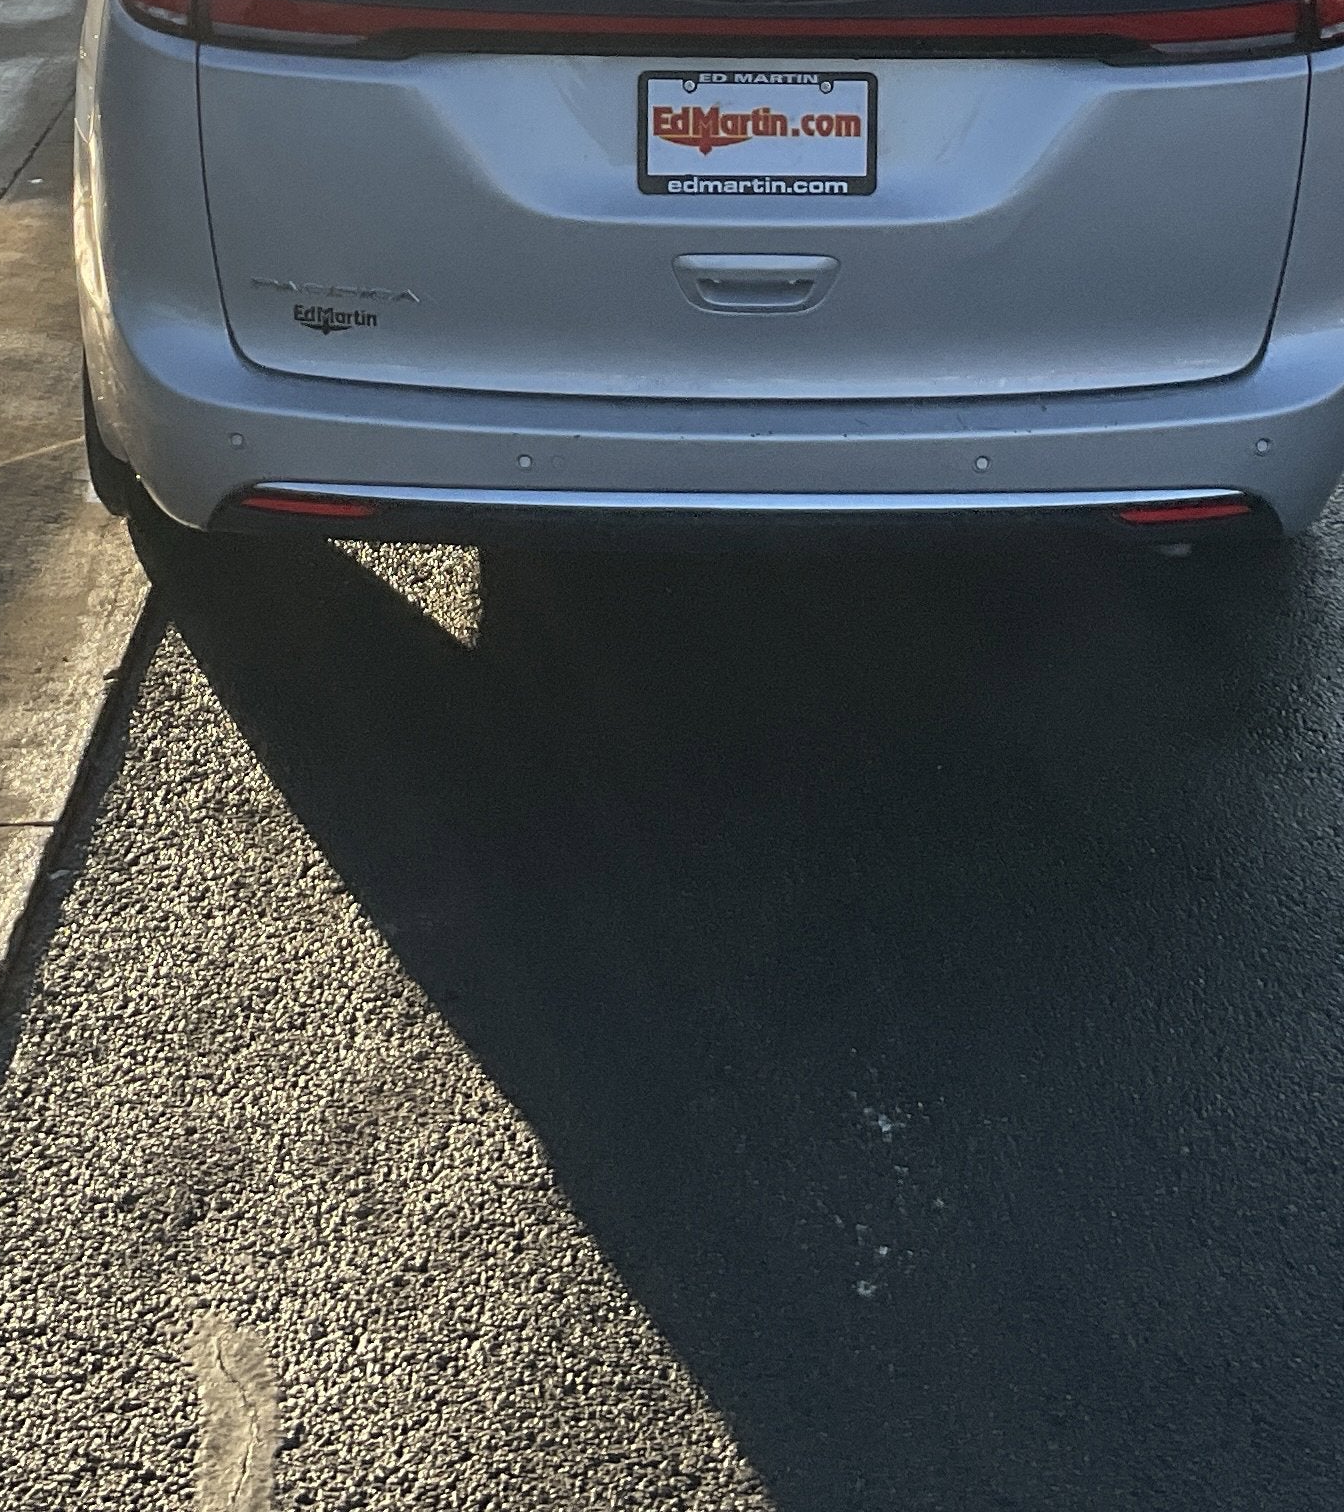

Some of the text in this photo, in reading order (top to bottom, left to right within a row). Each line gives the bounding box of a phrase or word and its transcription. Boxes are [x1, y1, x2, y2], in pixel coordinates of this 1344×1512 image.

[699, 73, 819, 84] ED MARTIN
[652, 105, 862, 138] EdMartin.com
[667, 176, 849, 194] edmartin.com
